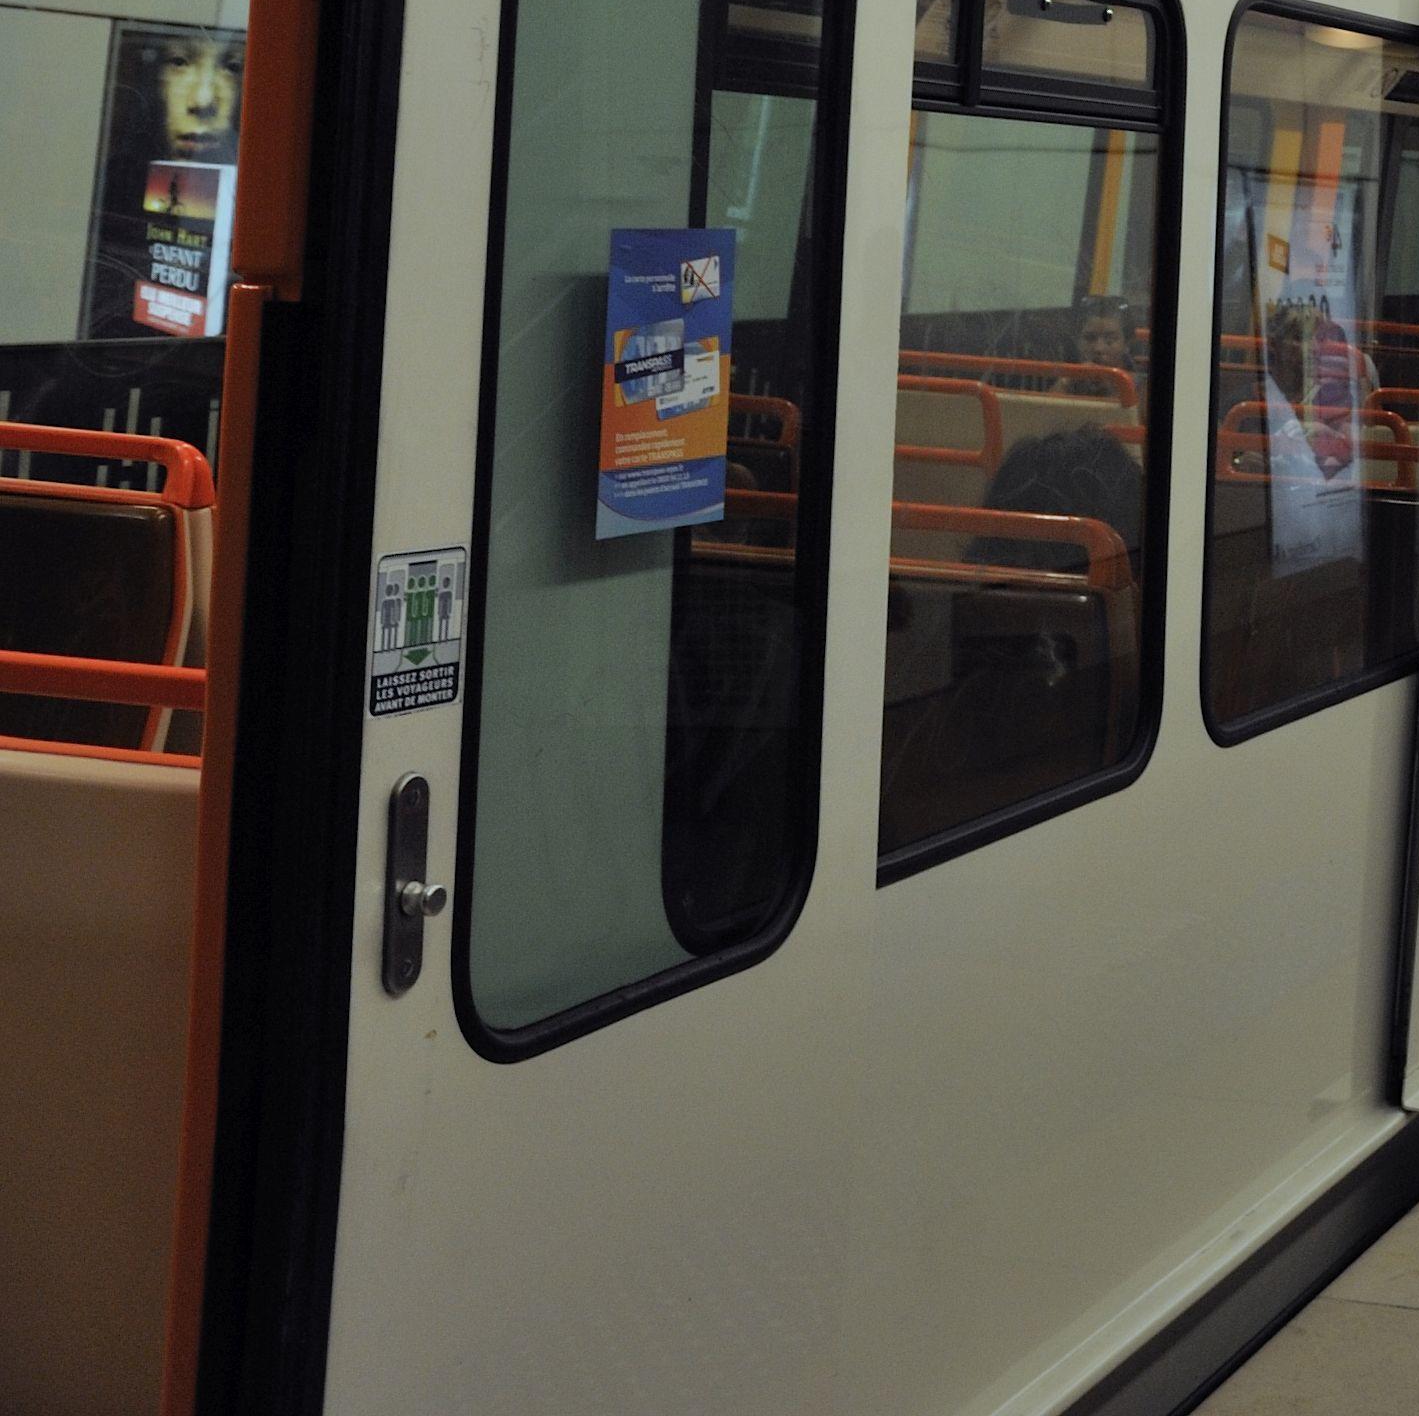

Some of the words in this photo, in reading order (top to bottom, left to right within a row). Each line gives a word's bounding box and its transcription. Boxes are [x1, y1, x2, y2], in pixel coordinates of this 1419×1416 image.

[150, 262, 200, 292] PERDU
[376, 688, 394, 700] LES
[397, 677, 453, 696] VOYAGEURS
[377, 672, 418, 688] LAISSEZ
[419, 666, 454, 682] SORTIR
[374, 698, 404, 712] AVANT
[404, 695, 416, 707] DE
[417, 689, 453, 704] MONTER
